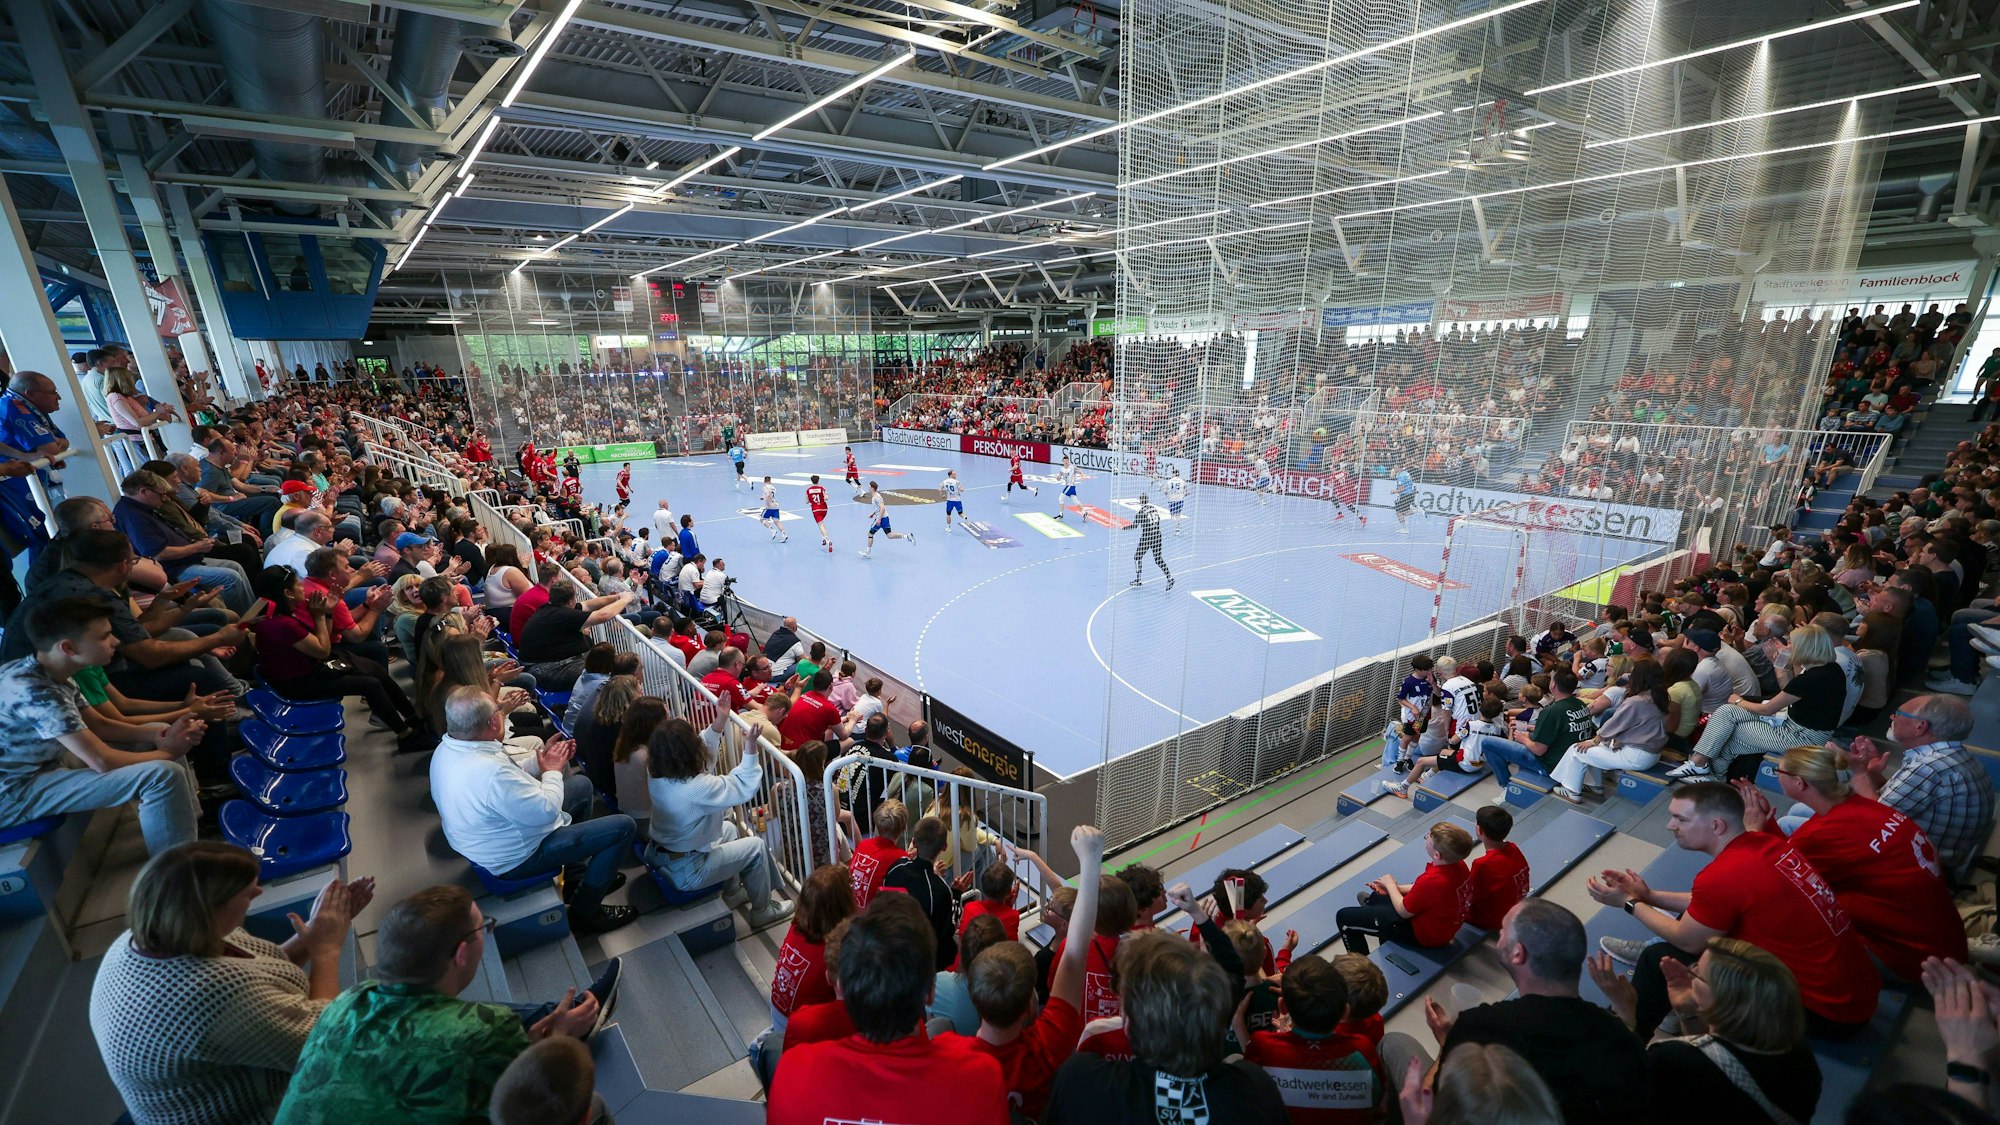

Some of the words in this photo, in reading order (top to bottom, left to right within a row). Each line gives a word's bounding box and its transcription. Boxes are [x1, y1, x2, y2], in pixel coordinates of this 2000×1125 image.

[1859, 271, 1961, 288] Familienblock
[887, 428, 952, 448] Stadtwerkessen
[811, 494, 821, 503] 21
[1410, 486, 1651, 538] tadtwerkessen
[934, 718, 1018, 781] westenergie
[1160, 1108, 1178, 1120] SV
